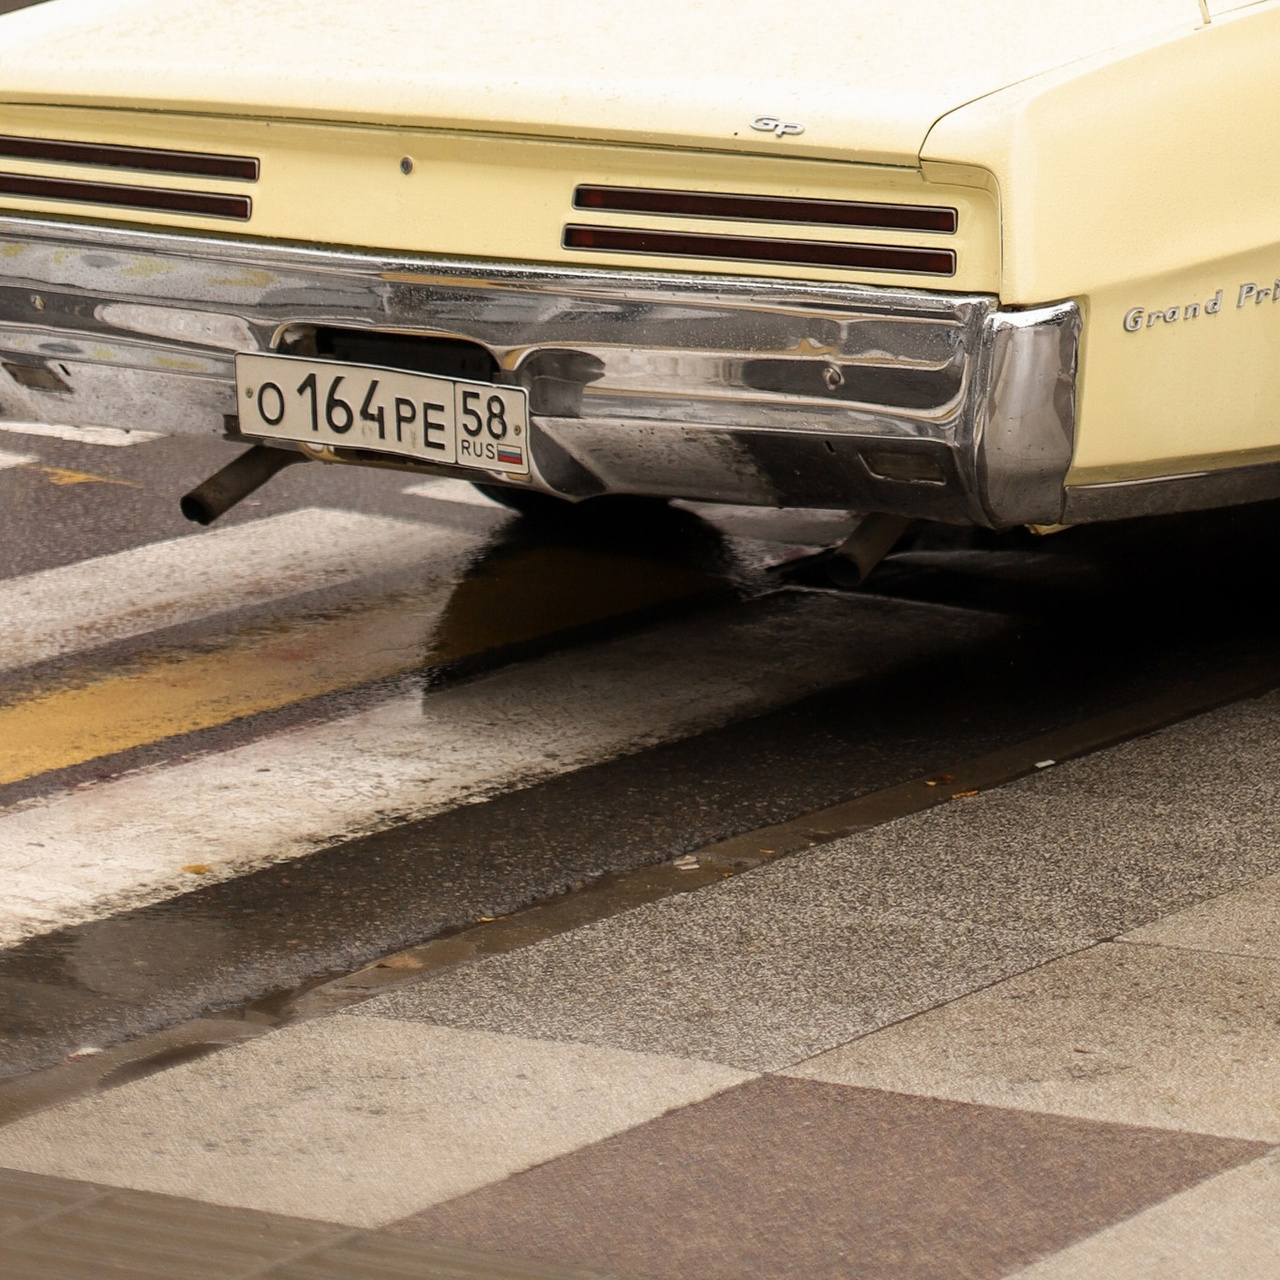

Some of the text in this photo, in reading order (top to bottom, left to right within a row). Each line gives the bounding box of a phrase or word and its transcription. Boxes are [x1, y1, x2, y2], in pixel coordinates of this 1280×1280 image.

[1123, 289, 1224, 332] Grand
[462, 390, 507, 440] 58
[461, 440, 496, 460] RUS
